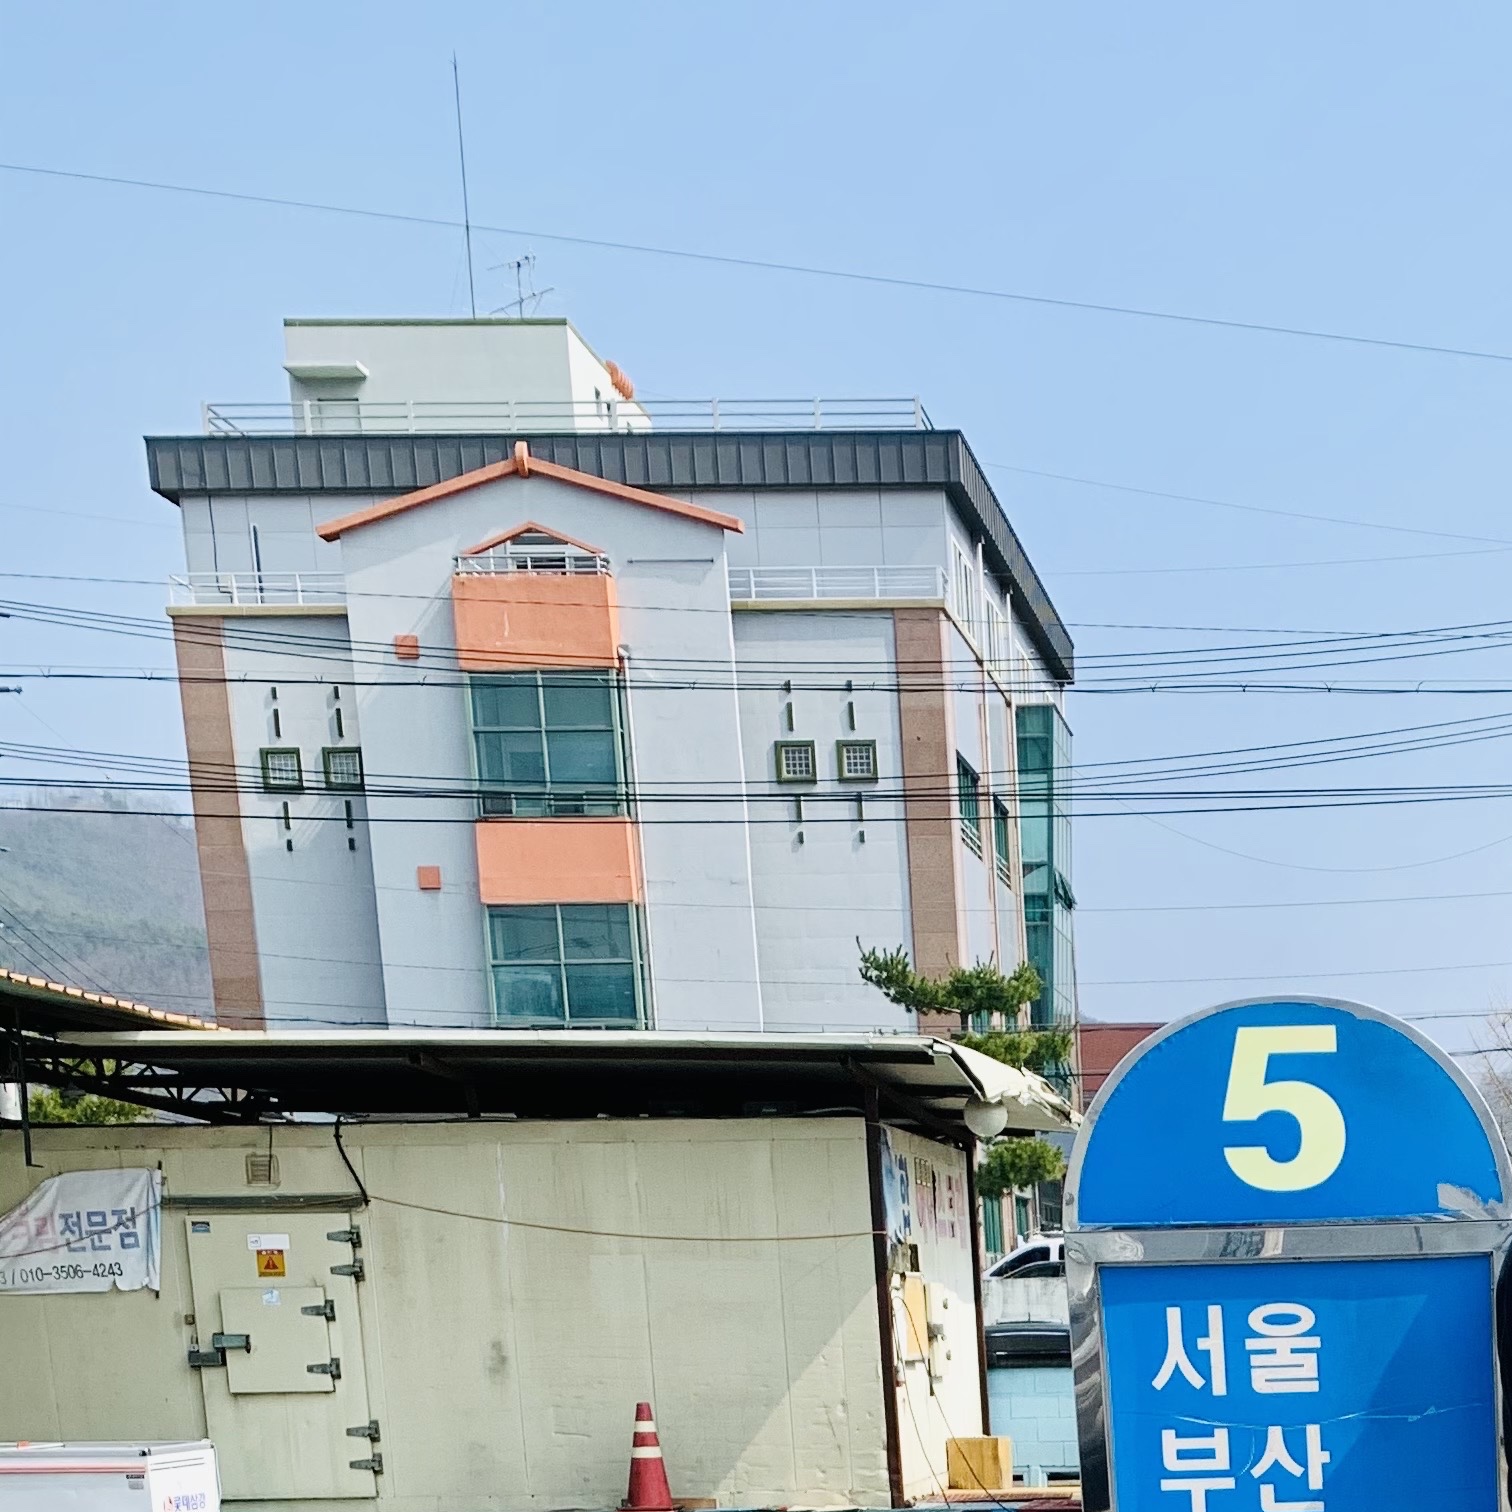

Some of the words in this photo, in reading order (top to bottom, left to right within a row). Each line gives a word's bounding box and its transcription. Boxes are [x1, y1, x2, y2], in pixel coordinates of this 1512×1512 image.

[1222, 1024, 1347, 1192] 5
[59, 1206, 141, 1253] 전문점
[20, 1262, 123, 1284] 010-3506-4243
[1152, 1302, 1322, 1396] 서울
